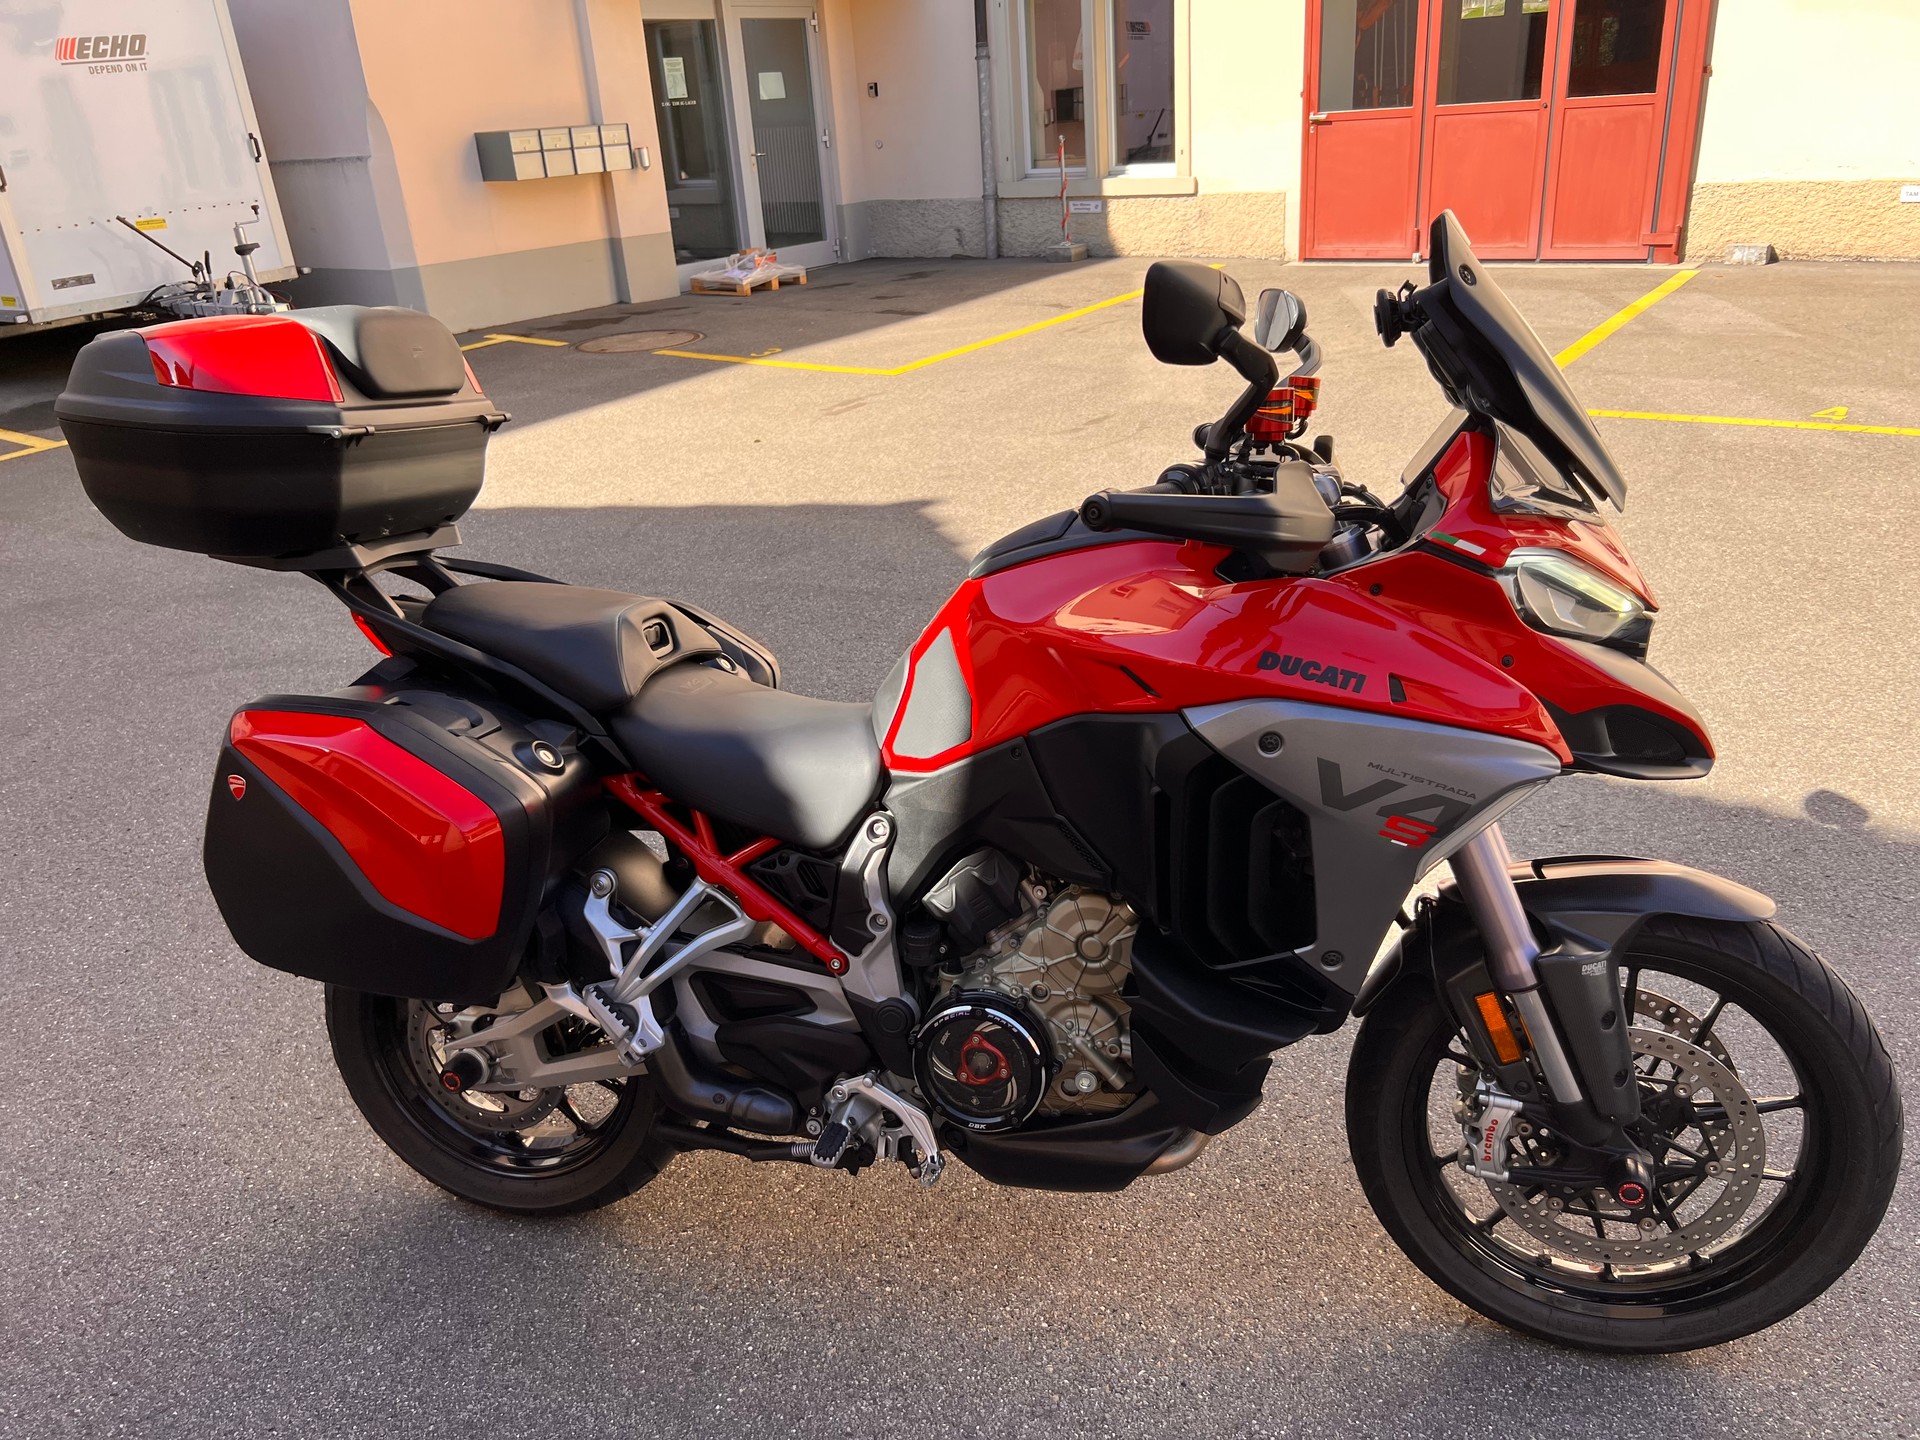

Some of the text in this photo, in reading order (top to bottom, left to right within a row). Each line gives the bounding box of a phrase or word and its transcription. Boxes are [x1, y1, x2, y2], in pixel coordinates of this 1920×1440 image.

[76, 34, 146, 59] ECHO
[88, 62, 148, 75] DEPEND ON IT
[1810, 406, 1848, 420] 4
[1257, 651, 1367, 694] DUCATI
[1367, 761, 1477, 800] MULTISTRADA
[1581, 960, 1607, 972] DUCATI
[968, 1122, 987, 1130] DBK
[1481, 1119, 1499, 1162] brembo
